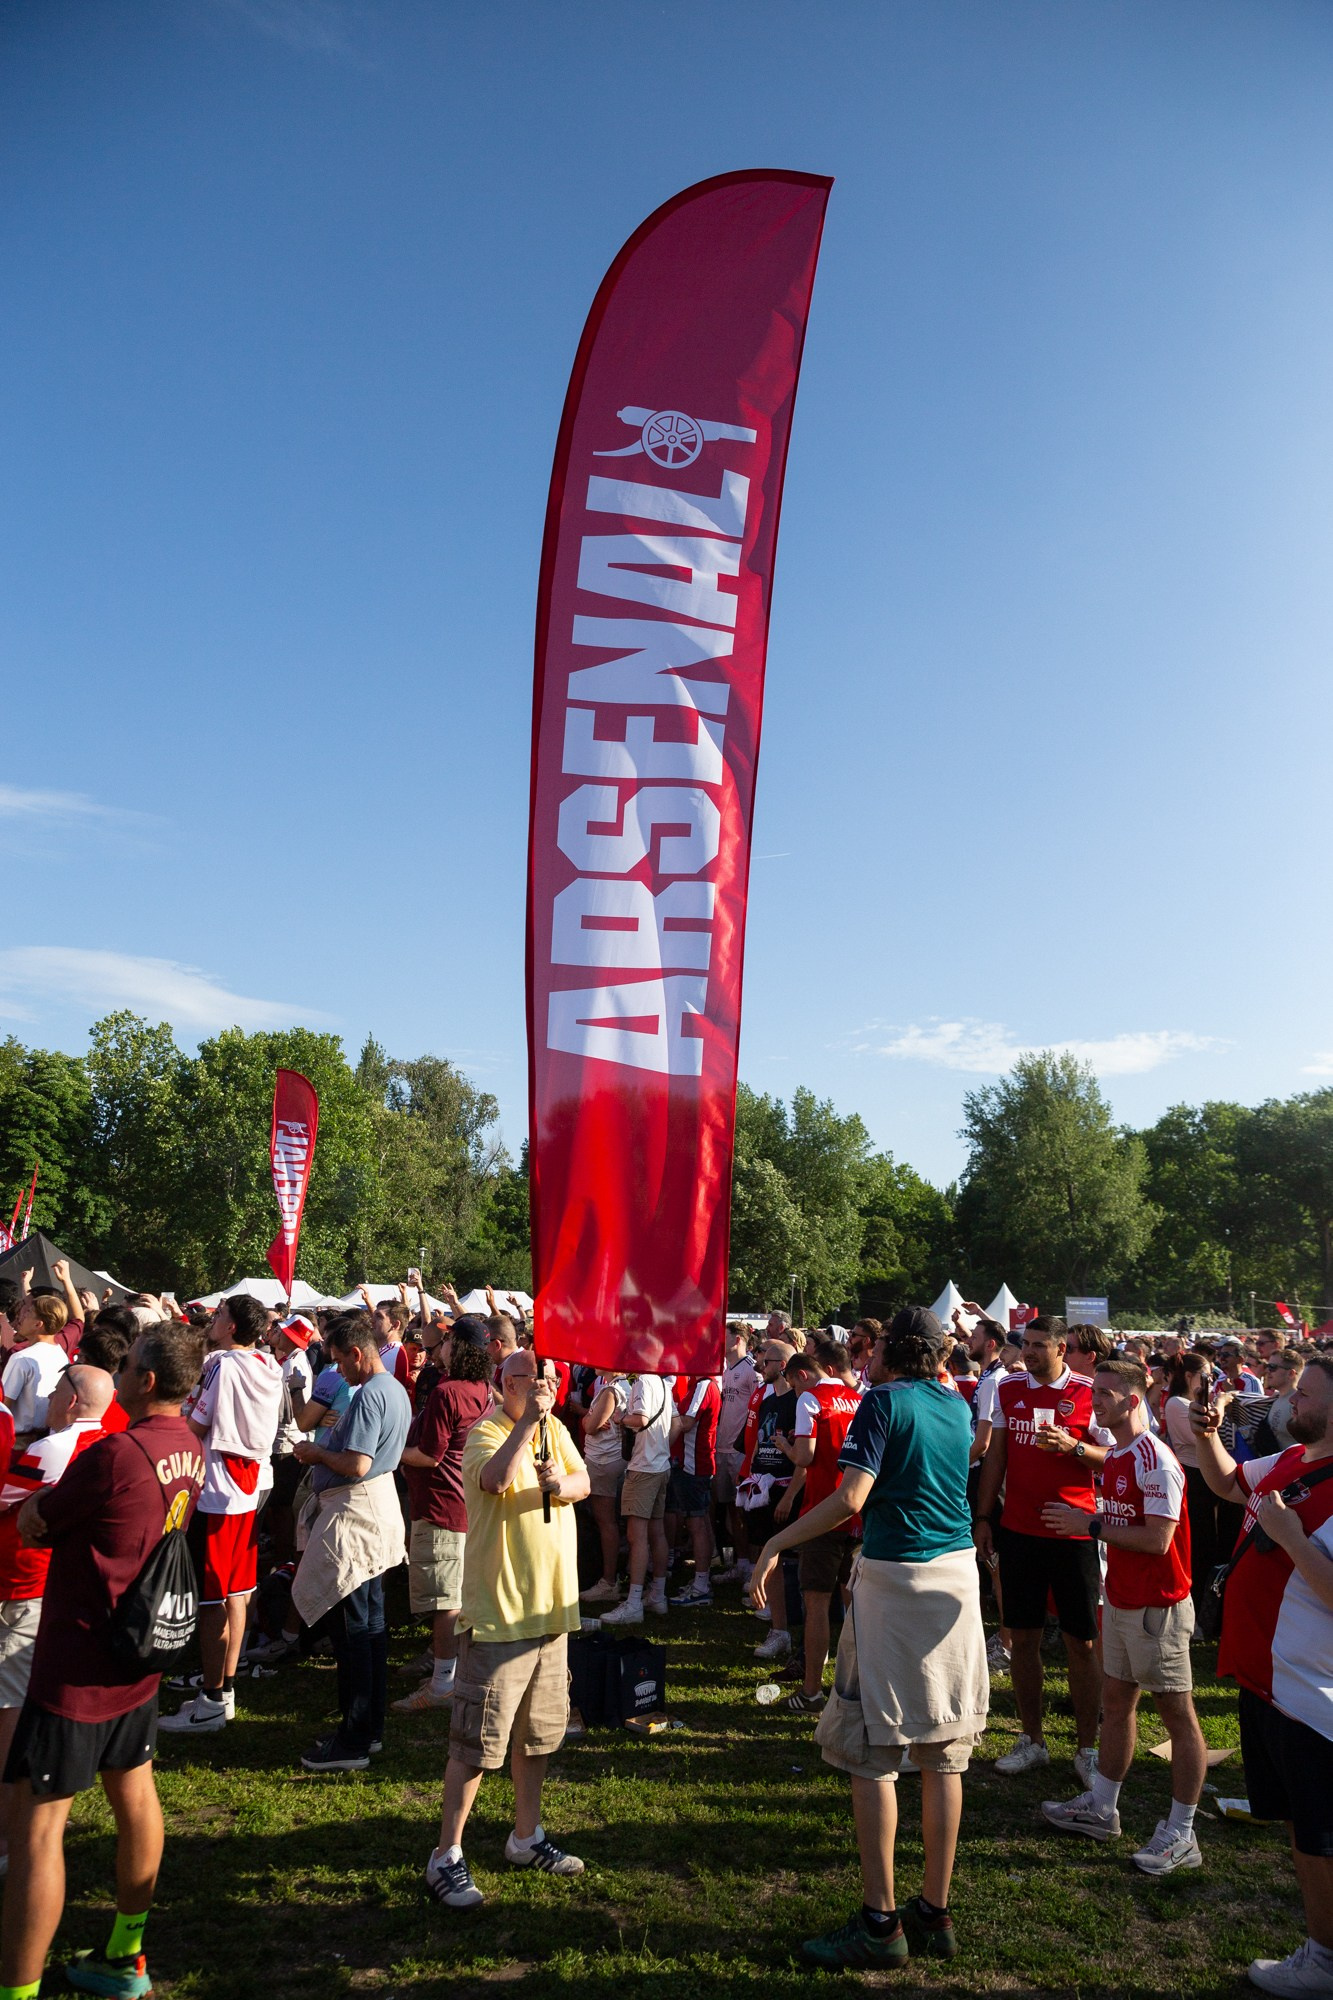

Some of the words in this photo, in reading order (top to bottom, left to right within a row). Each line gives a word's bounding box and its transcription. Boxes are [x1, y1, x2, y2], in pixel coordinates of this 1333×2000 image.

[546, 468, 750, 1078] ARSENAL
[1008, 1416, 1070, 1437] Emies
[1015, 1432, 1028, 1444] FLY
